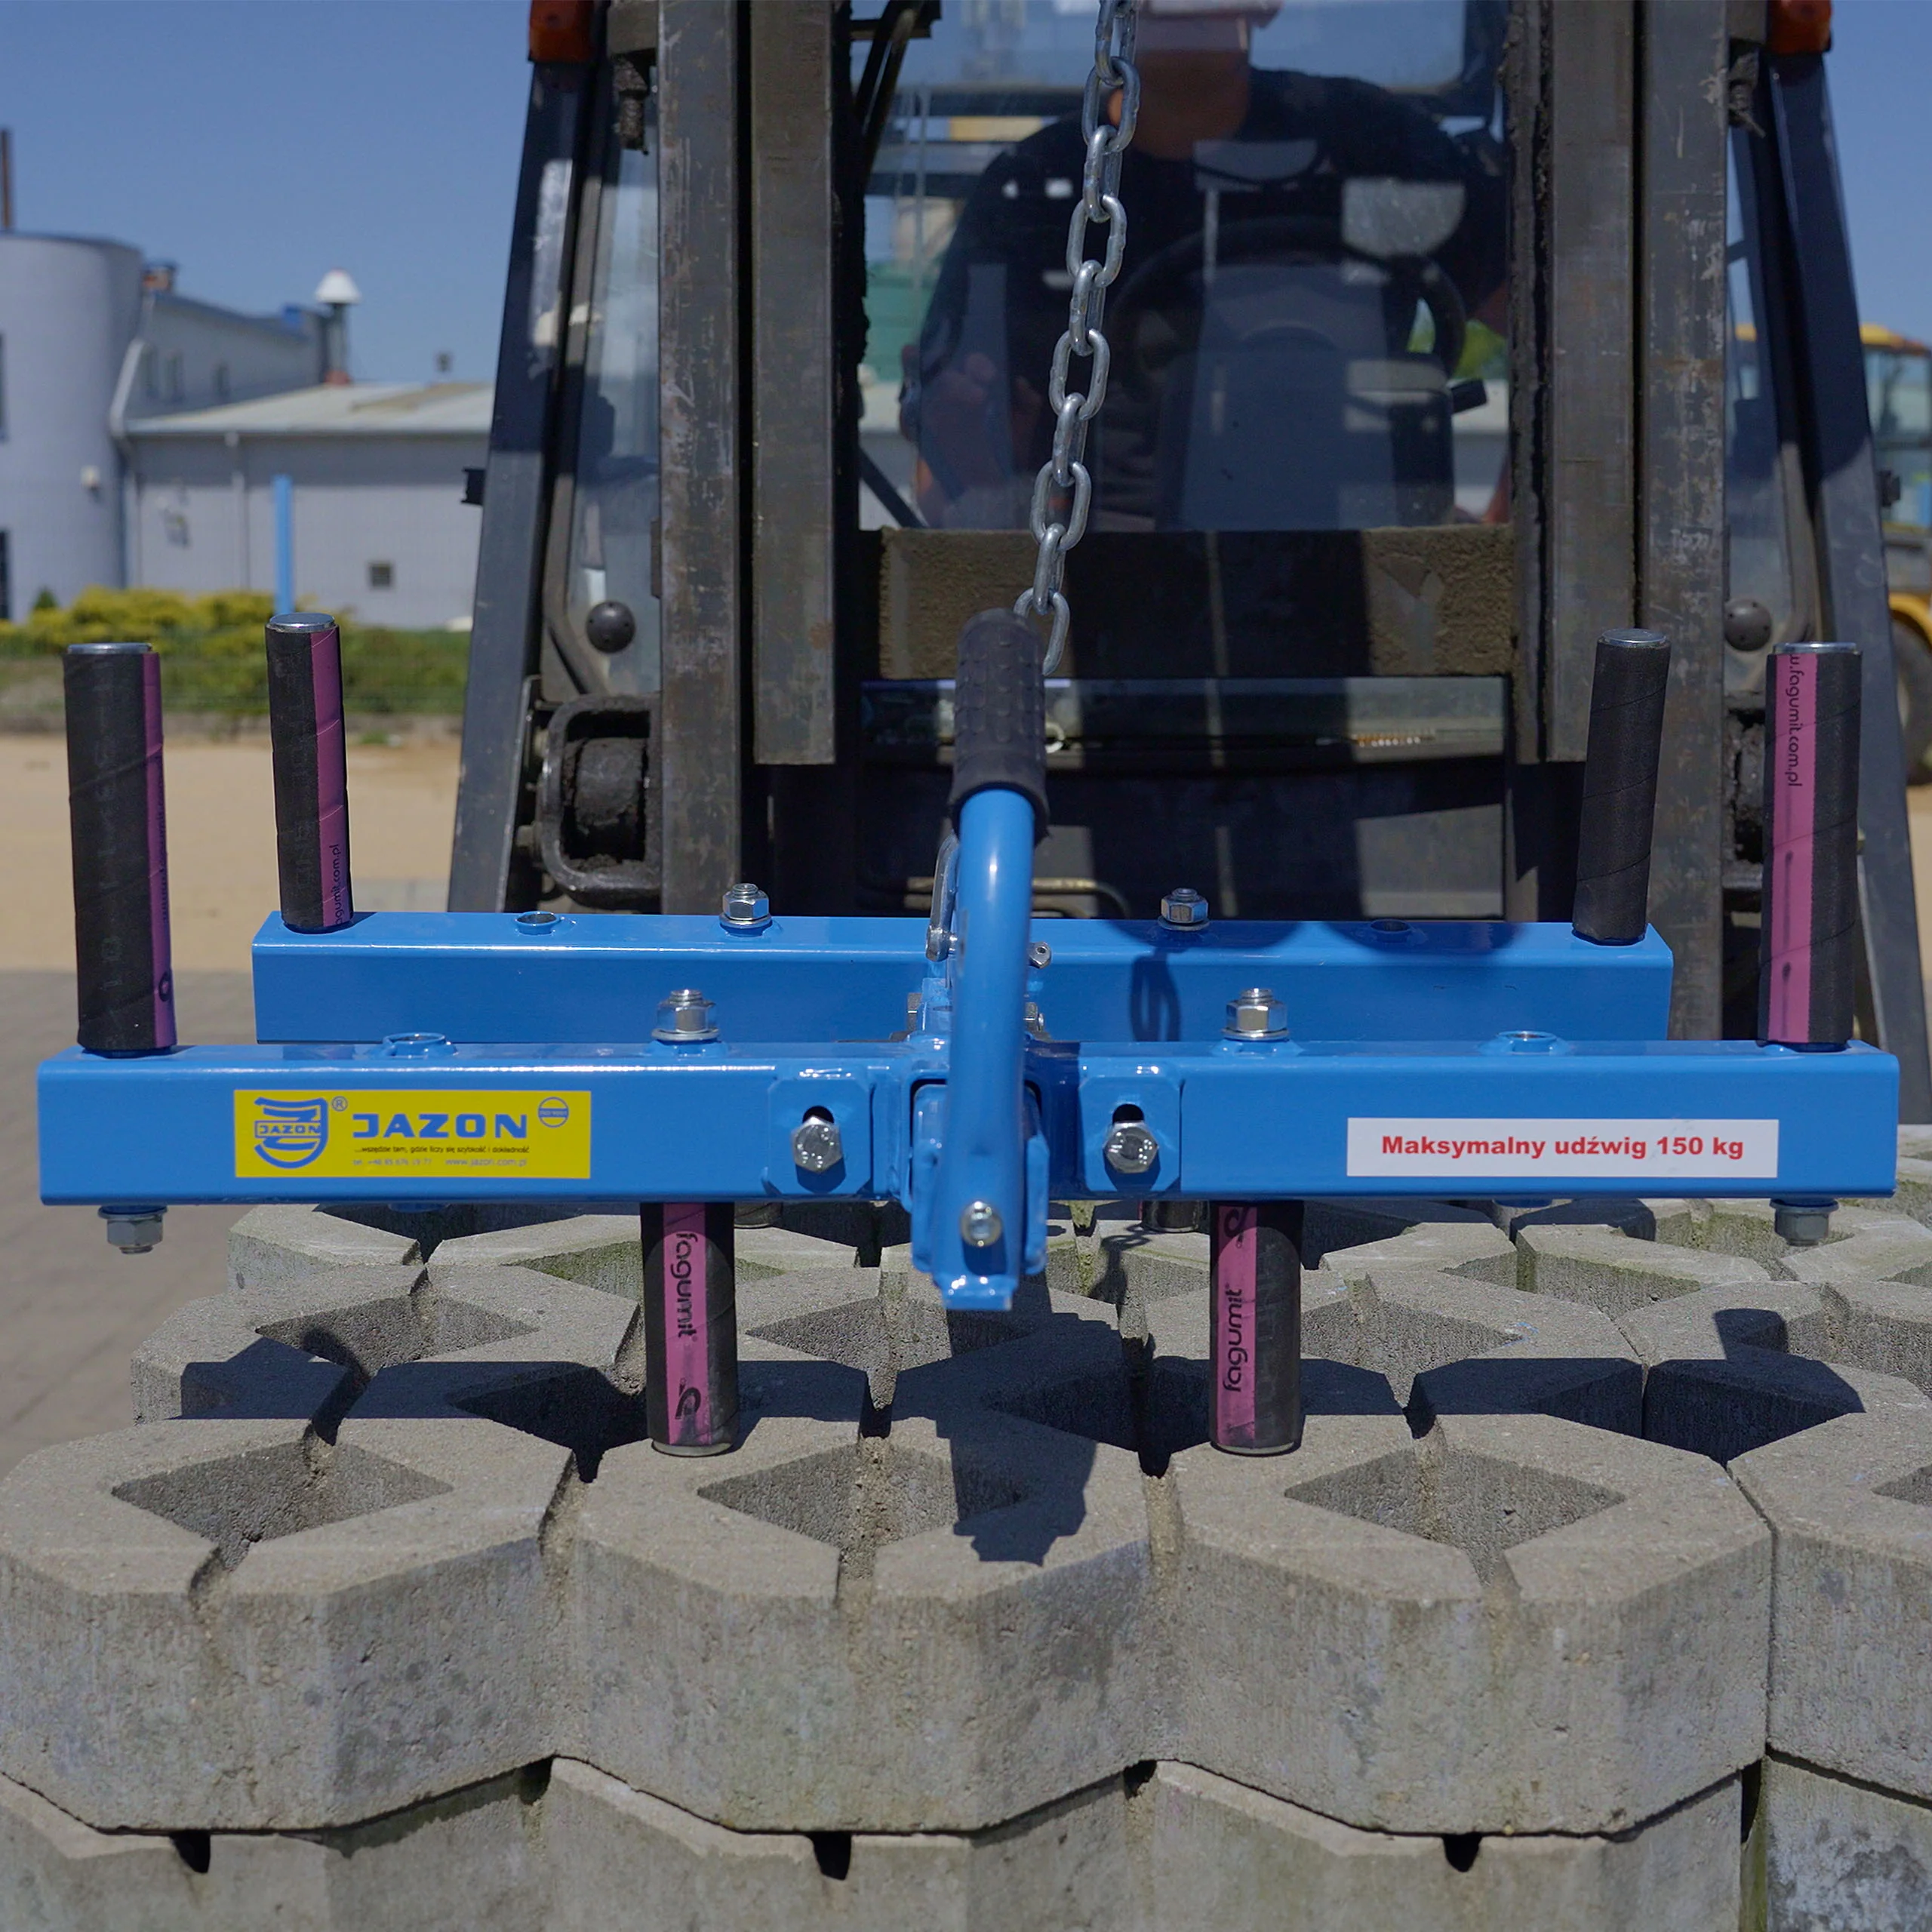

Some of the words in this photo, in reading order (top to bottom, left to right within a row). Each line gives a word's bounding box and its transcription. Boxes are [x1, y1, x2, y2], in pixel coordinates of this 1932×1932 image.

[259, 1124, 321, 1134] JAZON
[352, 1113, 527, 1139] JAZON
[1382, 1136, 1546, 1159] Maksymalny
[1555, 1136, 1647, 1160] udźwig
[1656, 1137, 1704, 1155] 150
[1712, 1137, 1744, 1160] kg
[669, 1232, 699, 1338] fagumit
[1223, 1288, 1248, 1392] fagumit
